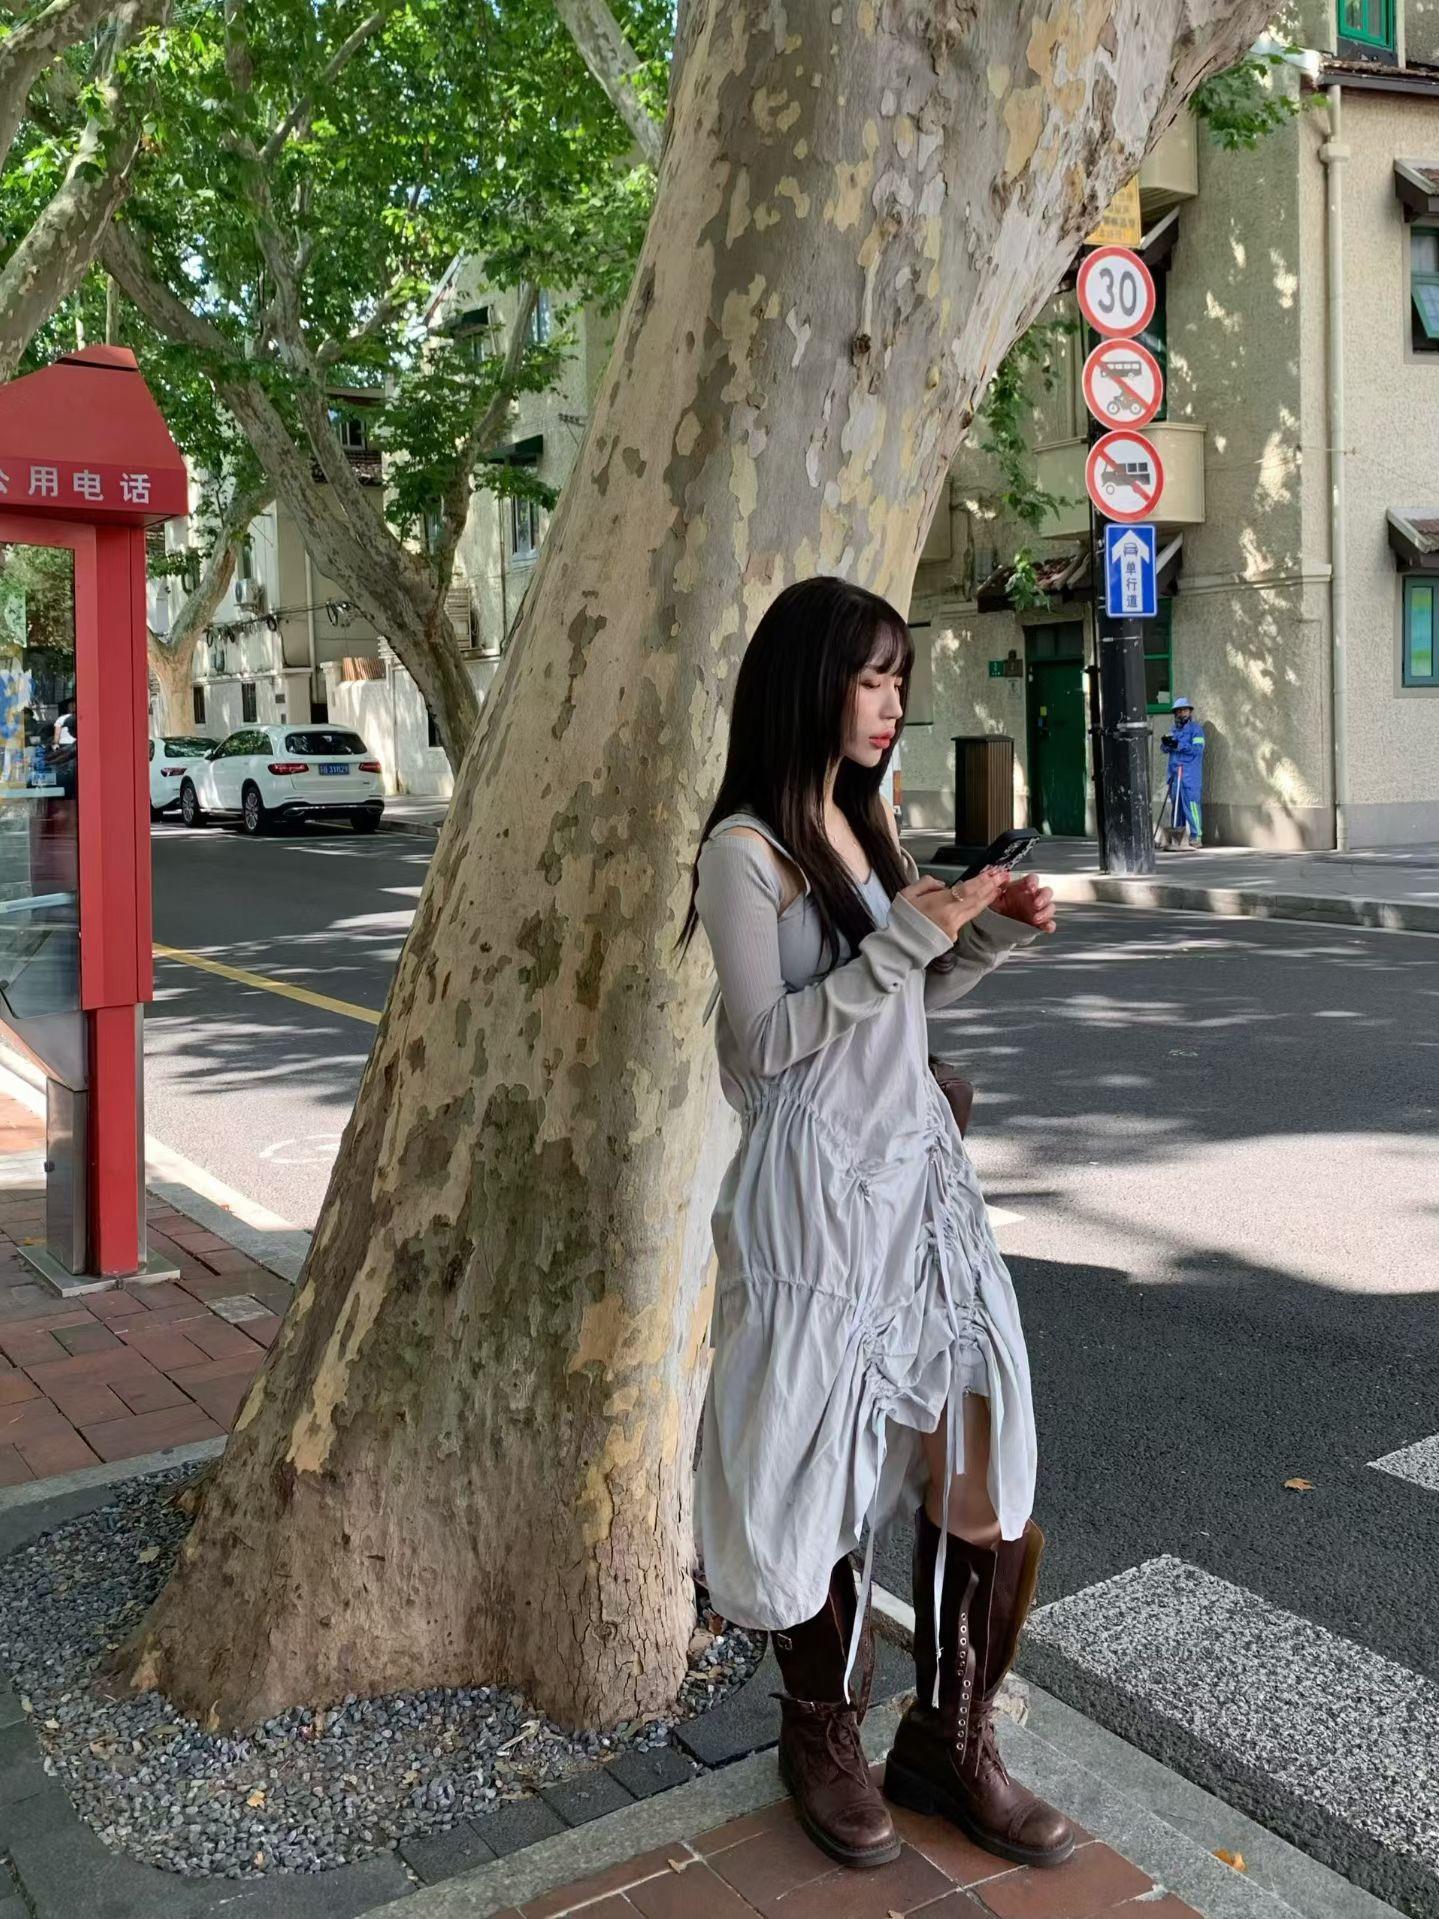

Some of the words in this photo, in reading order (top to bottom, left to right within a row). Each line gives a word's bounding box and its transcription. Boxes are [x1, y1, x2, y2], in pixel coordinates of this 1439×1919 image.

[1098, 267, 1137, 316] 30
[1125, 561, 1138, 608] 单行道
